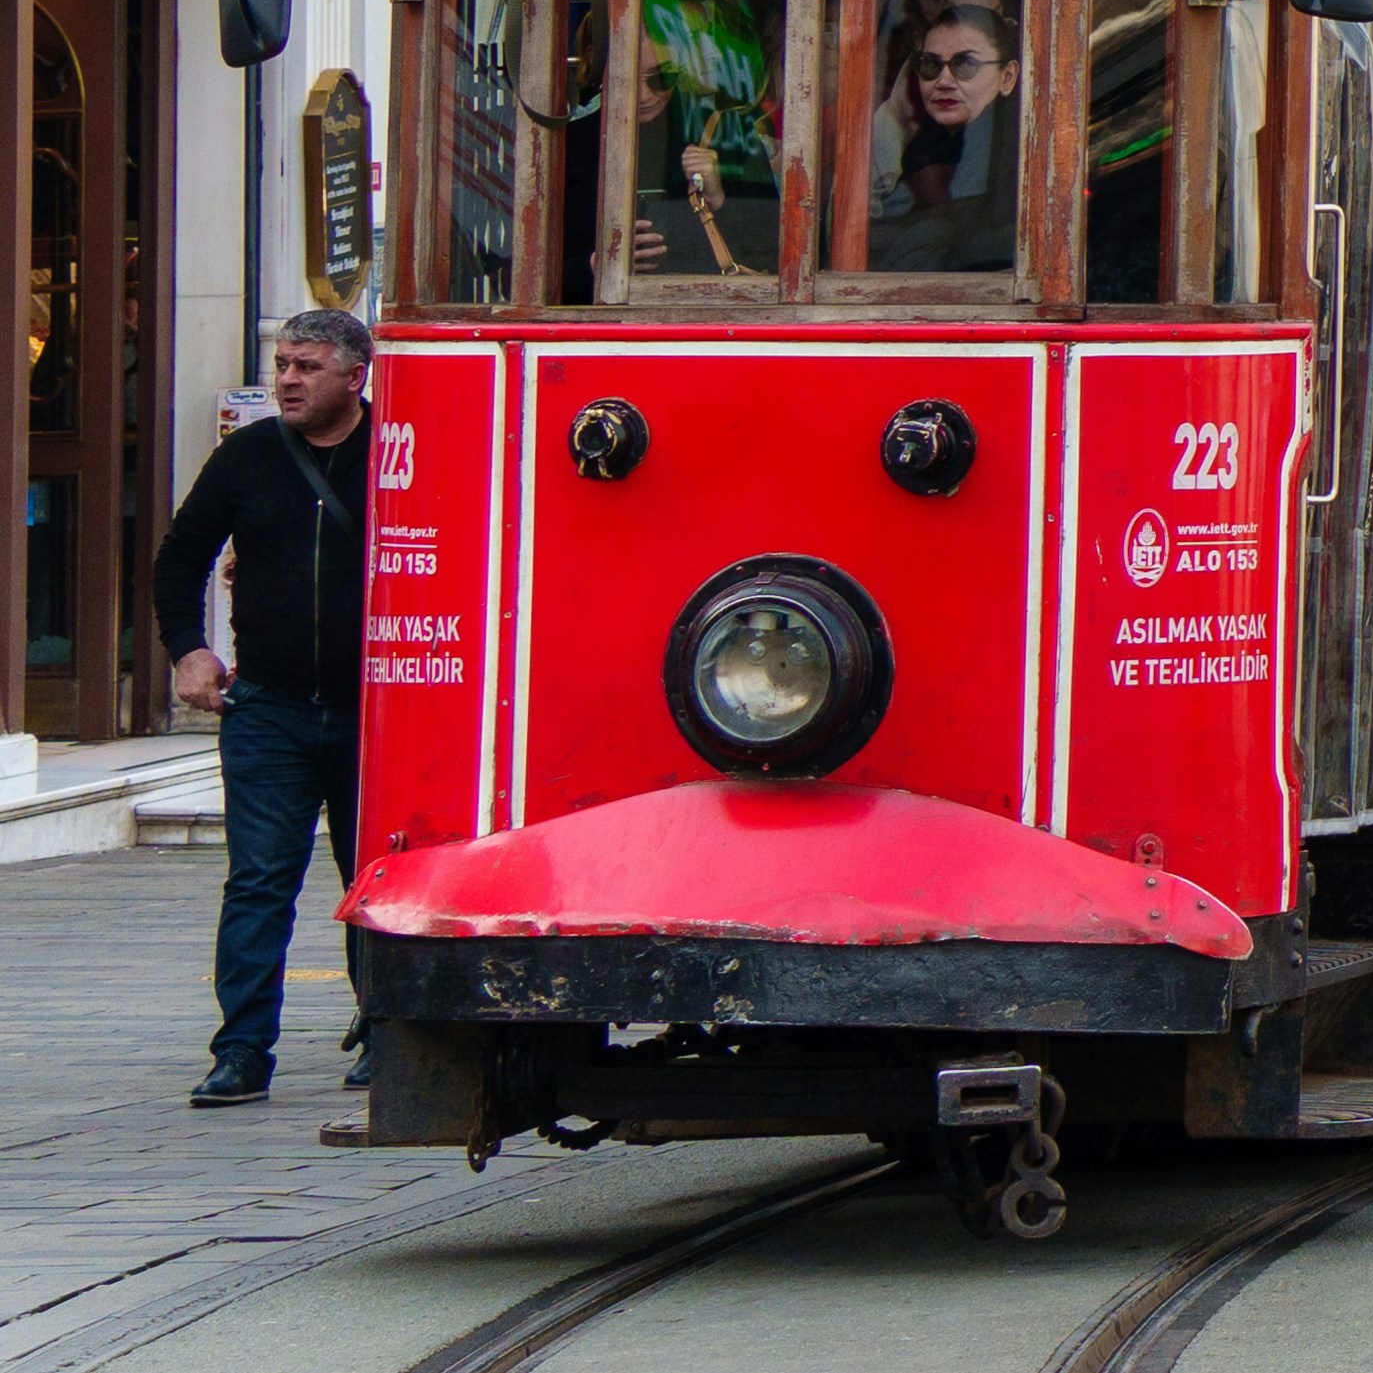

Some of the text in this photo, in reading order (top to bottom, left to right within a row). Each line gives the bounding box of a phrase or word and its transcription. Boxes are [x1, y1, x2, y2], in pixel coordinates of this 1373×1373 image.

[379, 421, 415, 490] 223
[1172, 422, 1239, 490] 223
[1177, 522, 1258, 537] www.iett.gov.tr
[379, 552, 402, 573] ALO
[405, 553, 437, 575] 153
[1176, 548, 1258, 572] ALO 153
[404, 615, 461, 642] YASAK
[1116, 613, 1267, 644] ASILMAK YASAK
[1110, 648, 1269, 686] VE TEHLİKELİDİR
